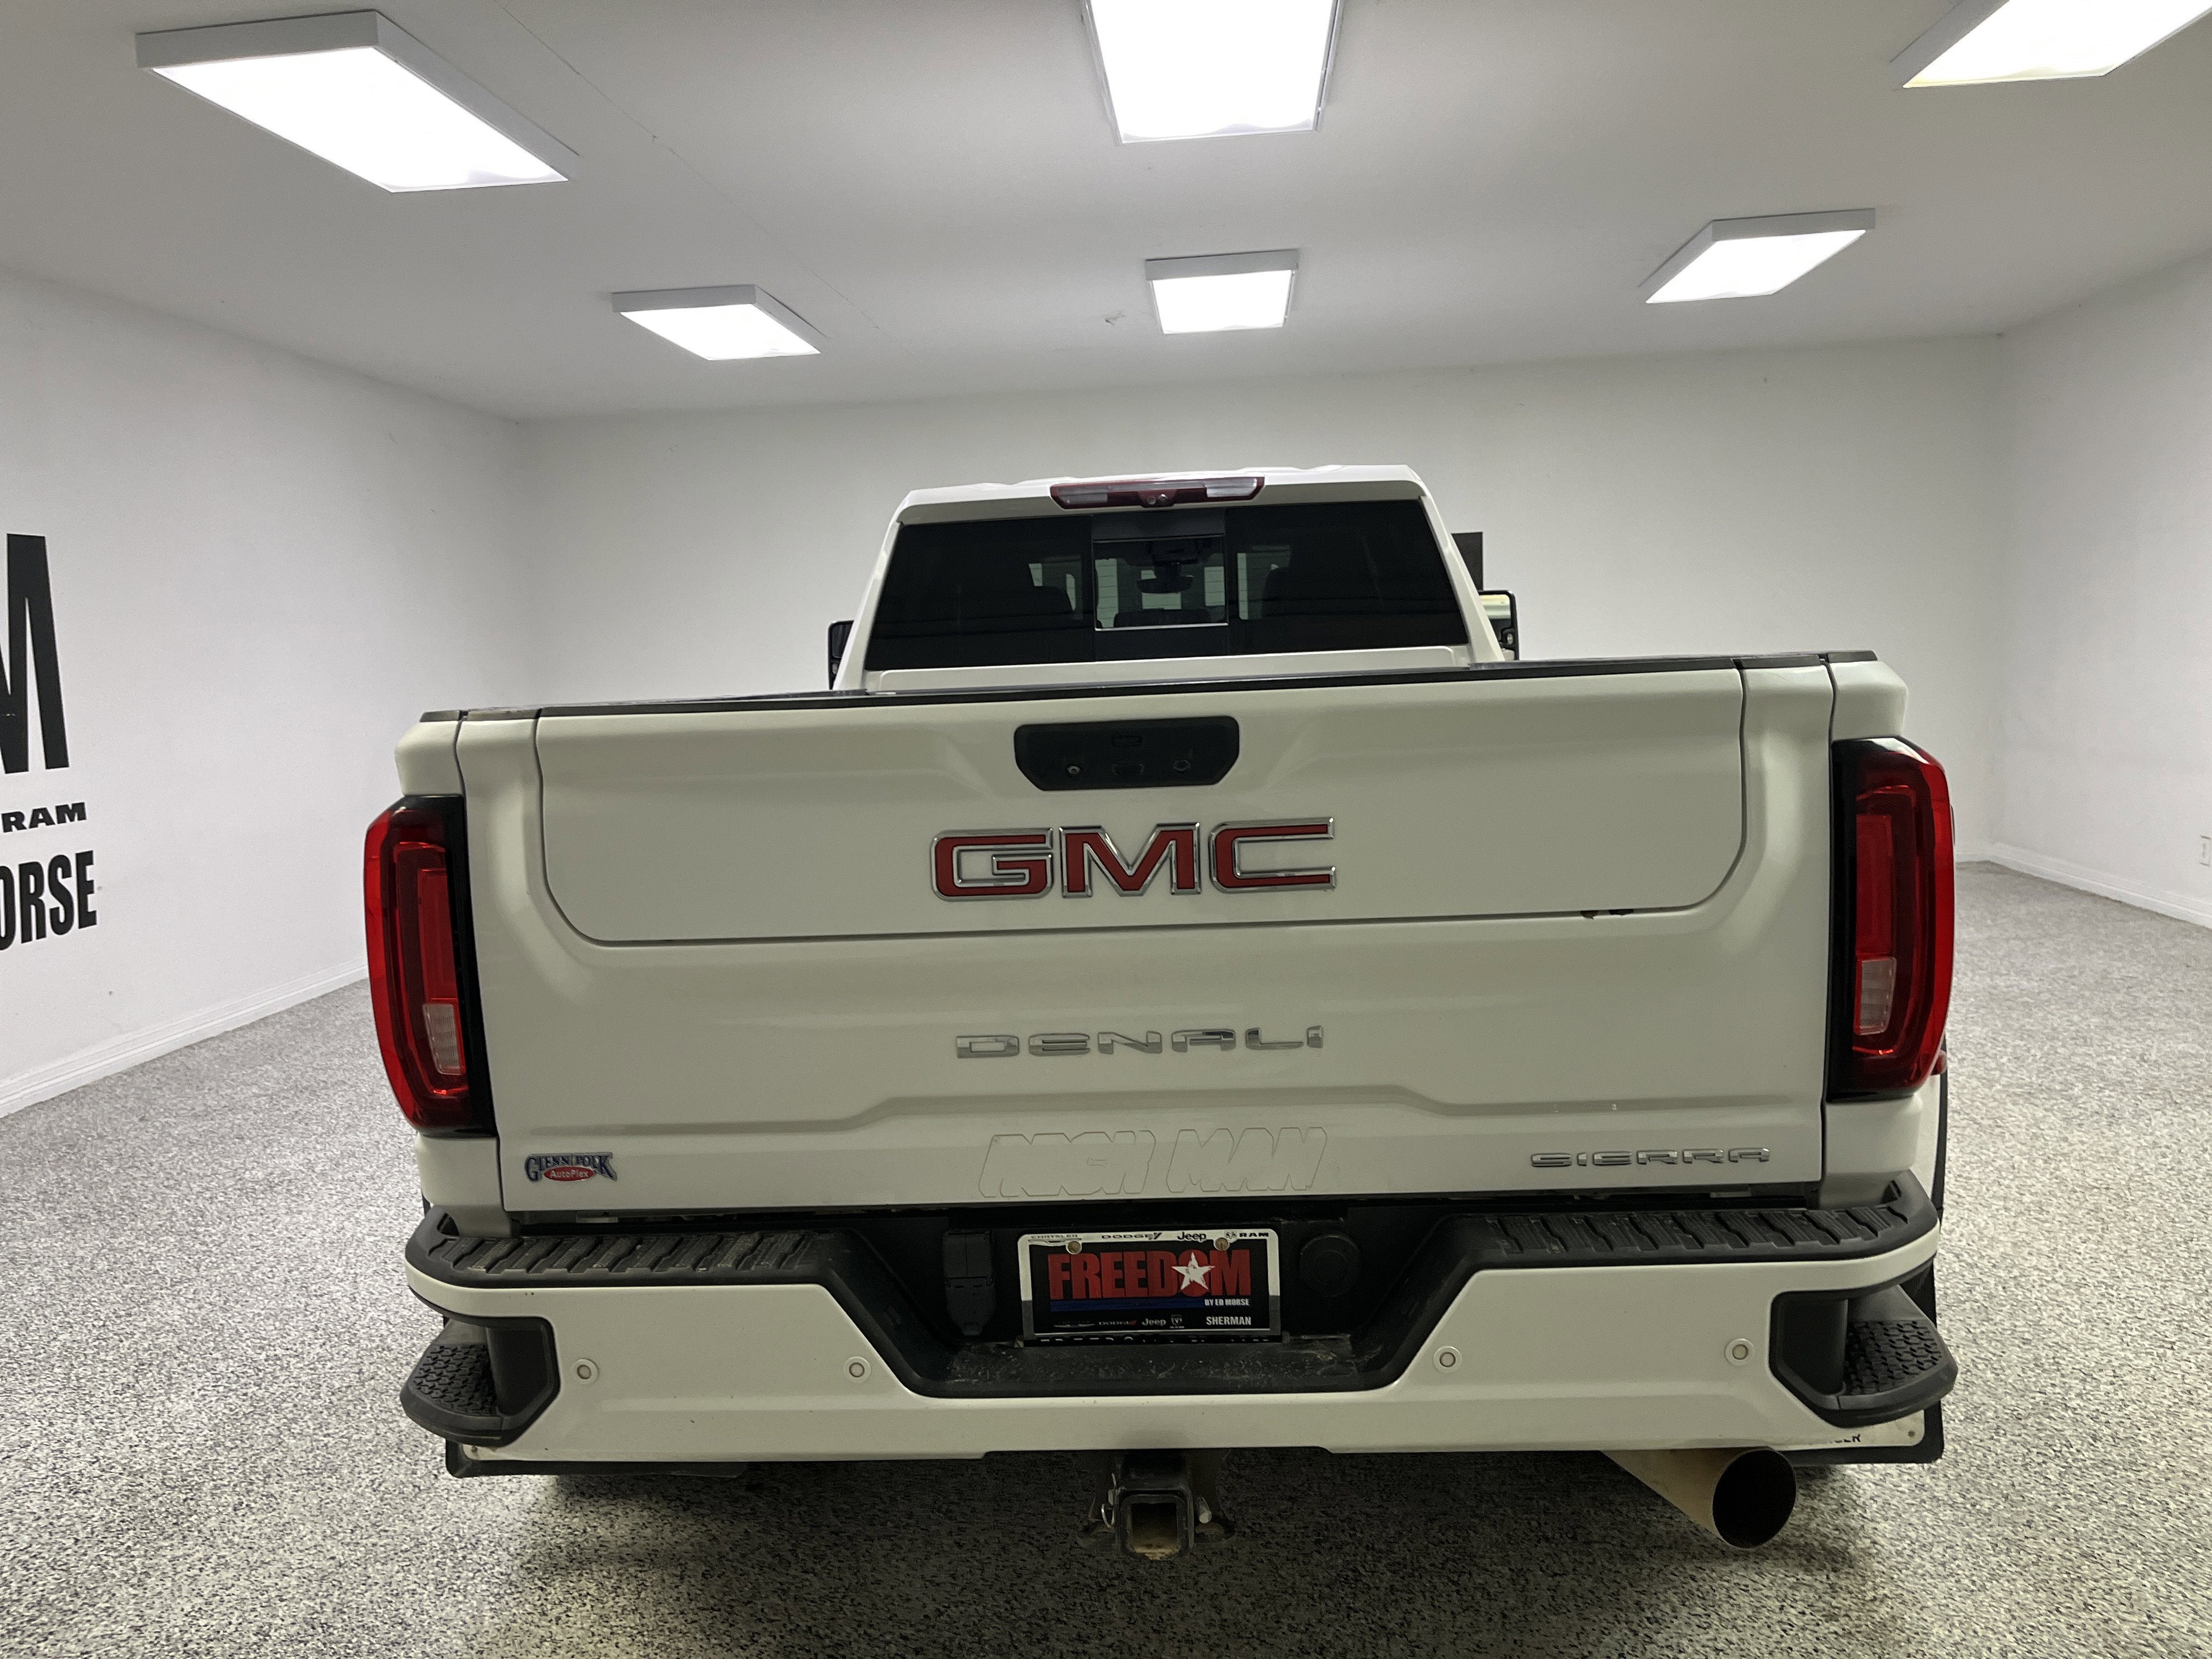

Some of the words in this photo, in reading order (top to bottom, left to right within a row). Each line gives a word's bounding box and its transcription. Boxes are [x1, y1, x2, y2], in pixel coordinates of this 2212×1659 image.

[1, 802, 87, 833] RAM
[930, 817, 1336, 902] GMC
[956, 1025, 1323, 1058] DENALI
[1531, 1147, 1769, 1167] SIERRA
[550, 1170, 589, 1178] AutoPlex
[1177, 1231, 1206, 1240] Jeep
[1048, 1249, 1251, 1300] FREEDOM
[1142, 1318, 1166, 1326] Jeep
[1206, 1316, 1251, 1325] SHERMAN
